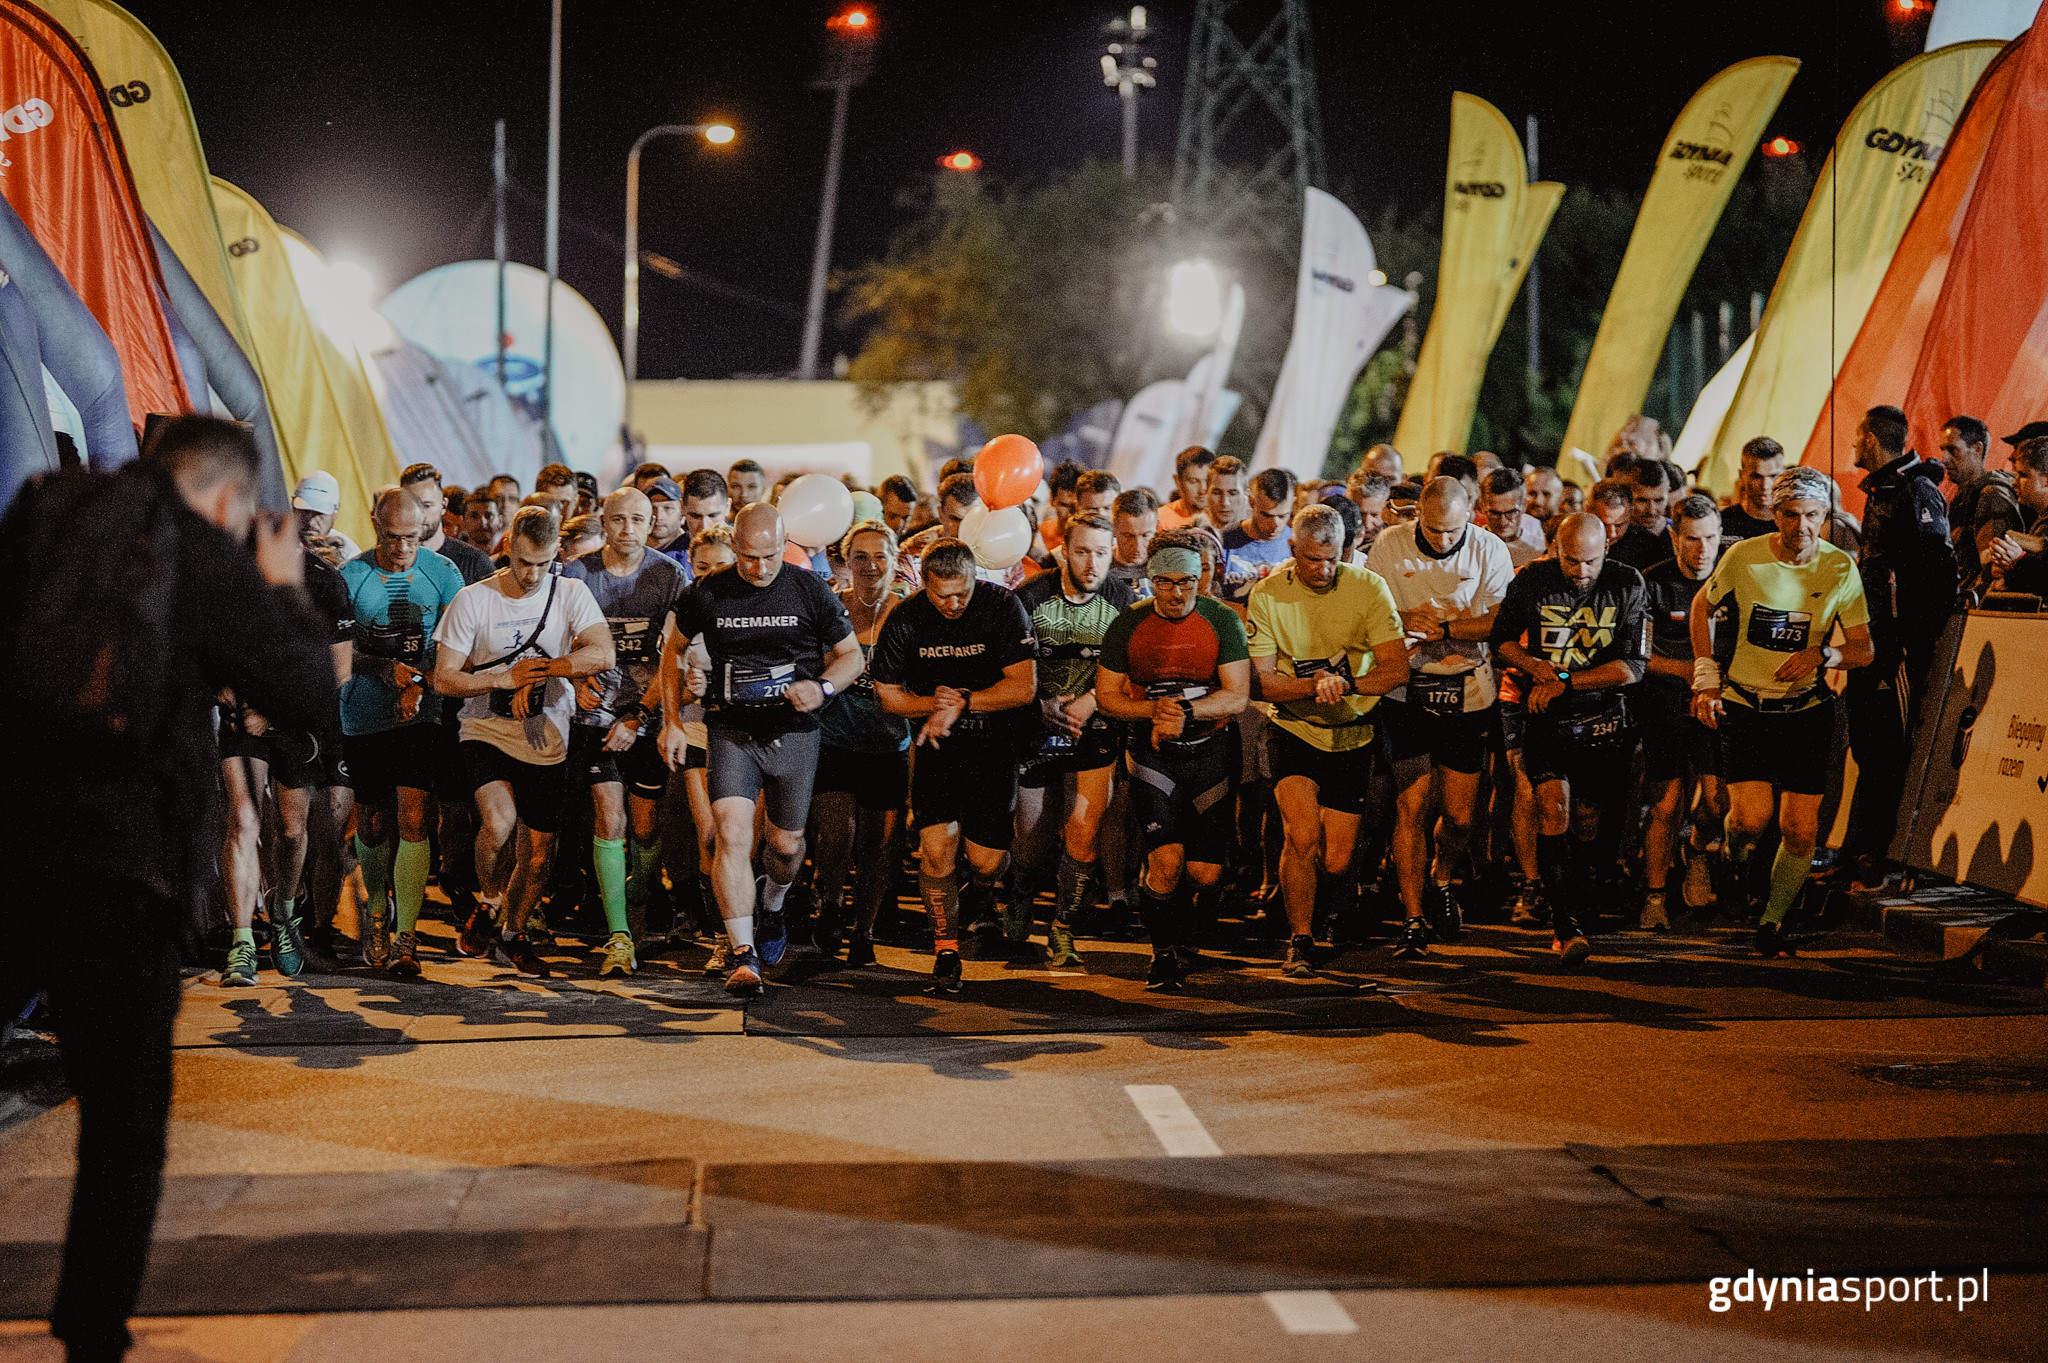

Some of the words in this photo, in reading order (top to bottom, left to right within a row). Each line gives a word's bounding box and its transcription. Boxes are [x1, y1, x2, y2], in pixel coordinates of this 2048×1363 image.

[716, 615, 799, 629] PACEMAKER
[1770, 626, 1803, 642] 1273
[403, 639, 419, 653] 38
[617, 639, 643, 652] 342
[1428, 691, 1459, 704] 1776
[1592, 720, 1619, 737] 2347
[1997, 757, 2025, 779] razem
